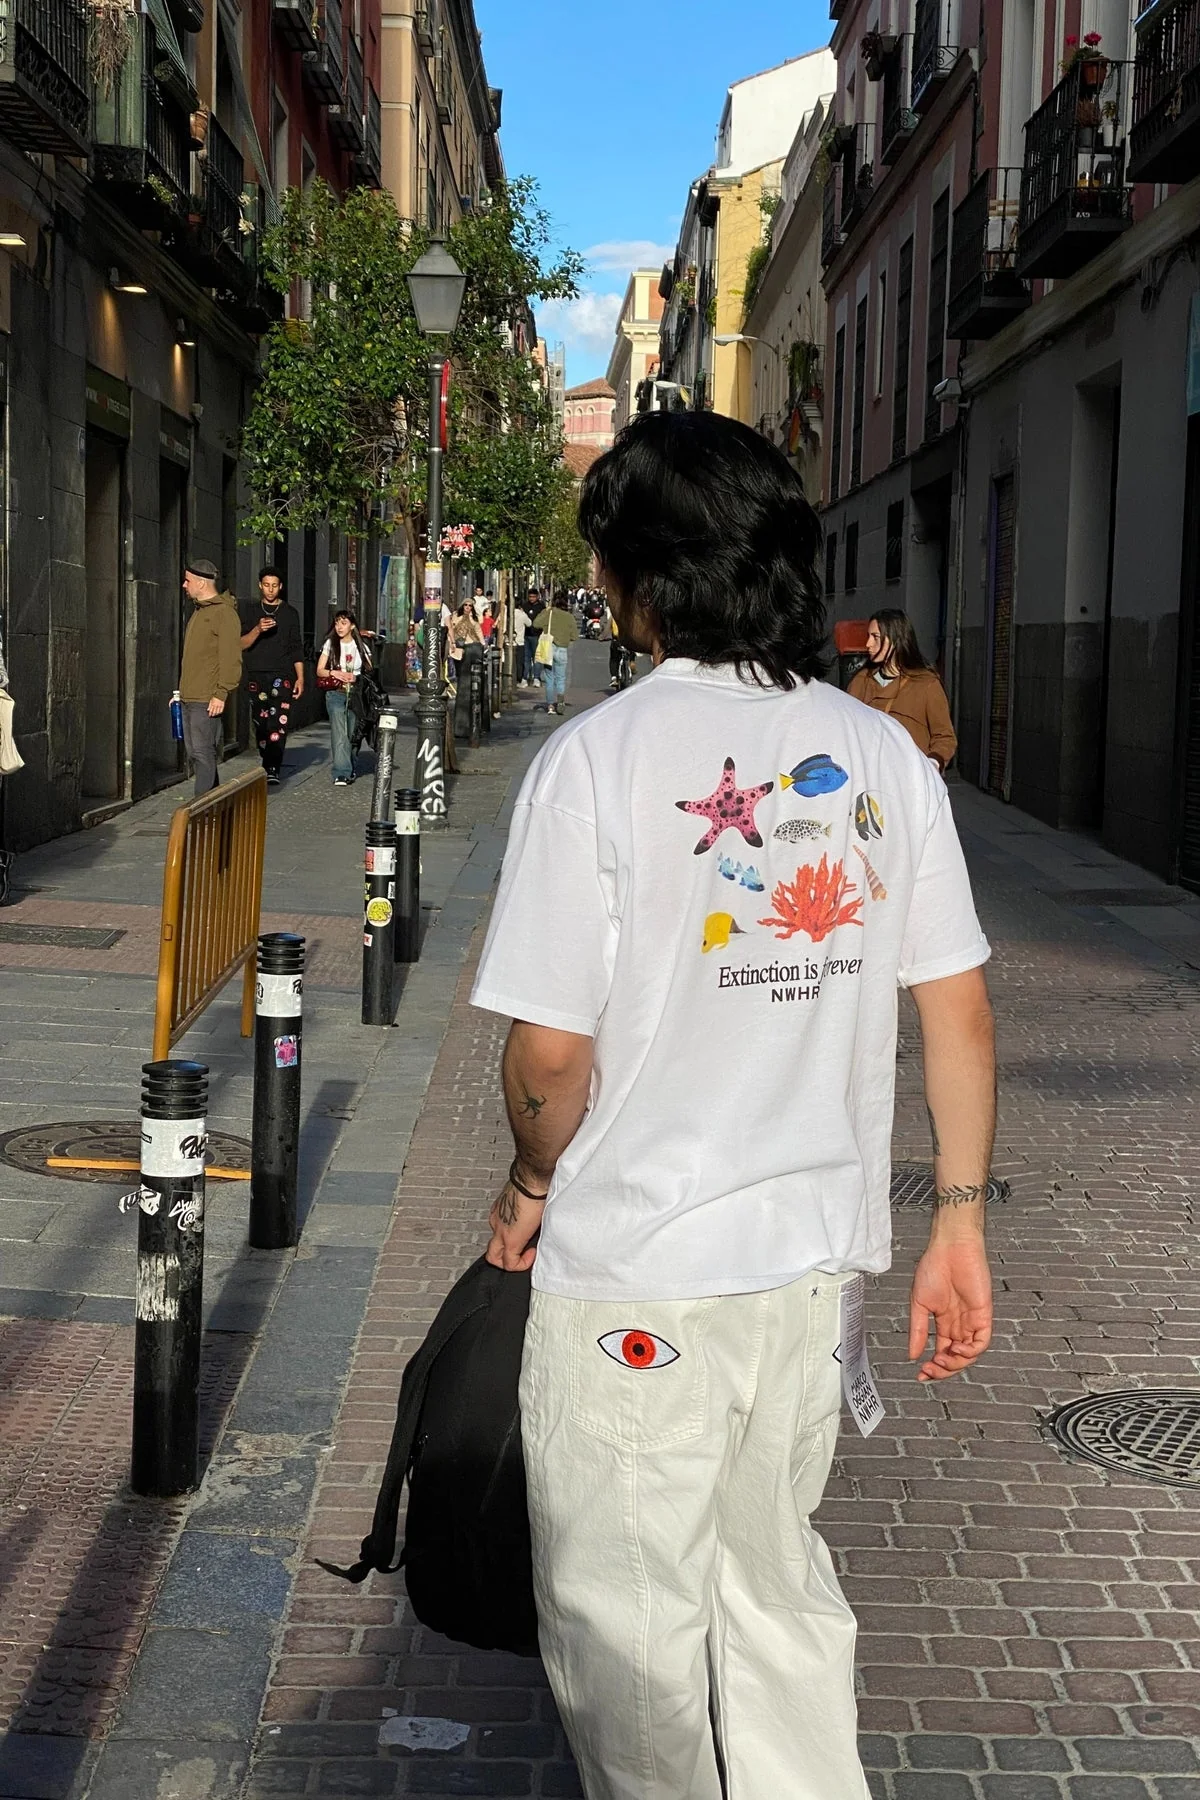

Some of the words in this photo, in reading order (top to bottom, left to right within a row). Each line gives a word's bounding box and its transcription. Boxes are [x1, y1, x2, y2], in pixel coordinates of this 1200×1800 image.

[718, 960, 800, 988] Extinction
[804, 957, 818, 980] is
[818, 956, 863, 984] frever
[771, 985, 820, 1003] NWHR
[858, 1394, 880, 1425] NWHR
[1081, 1400, 1155, 1454] REGISTRO
